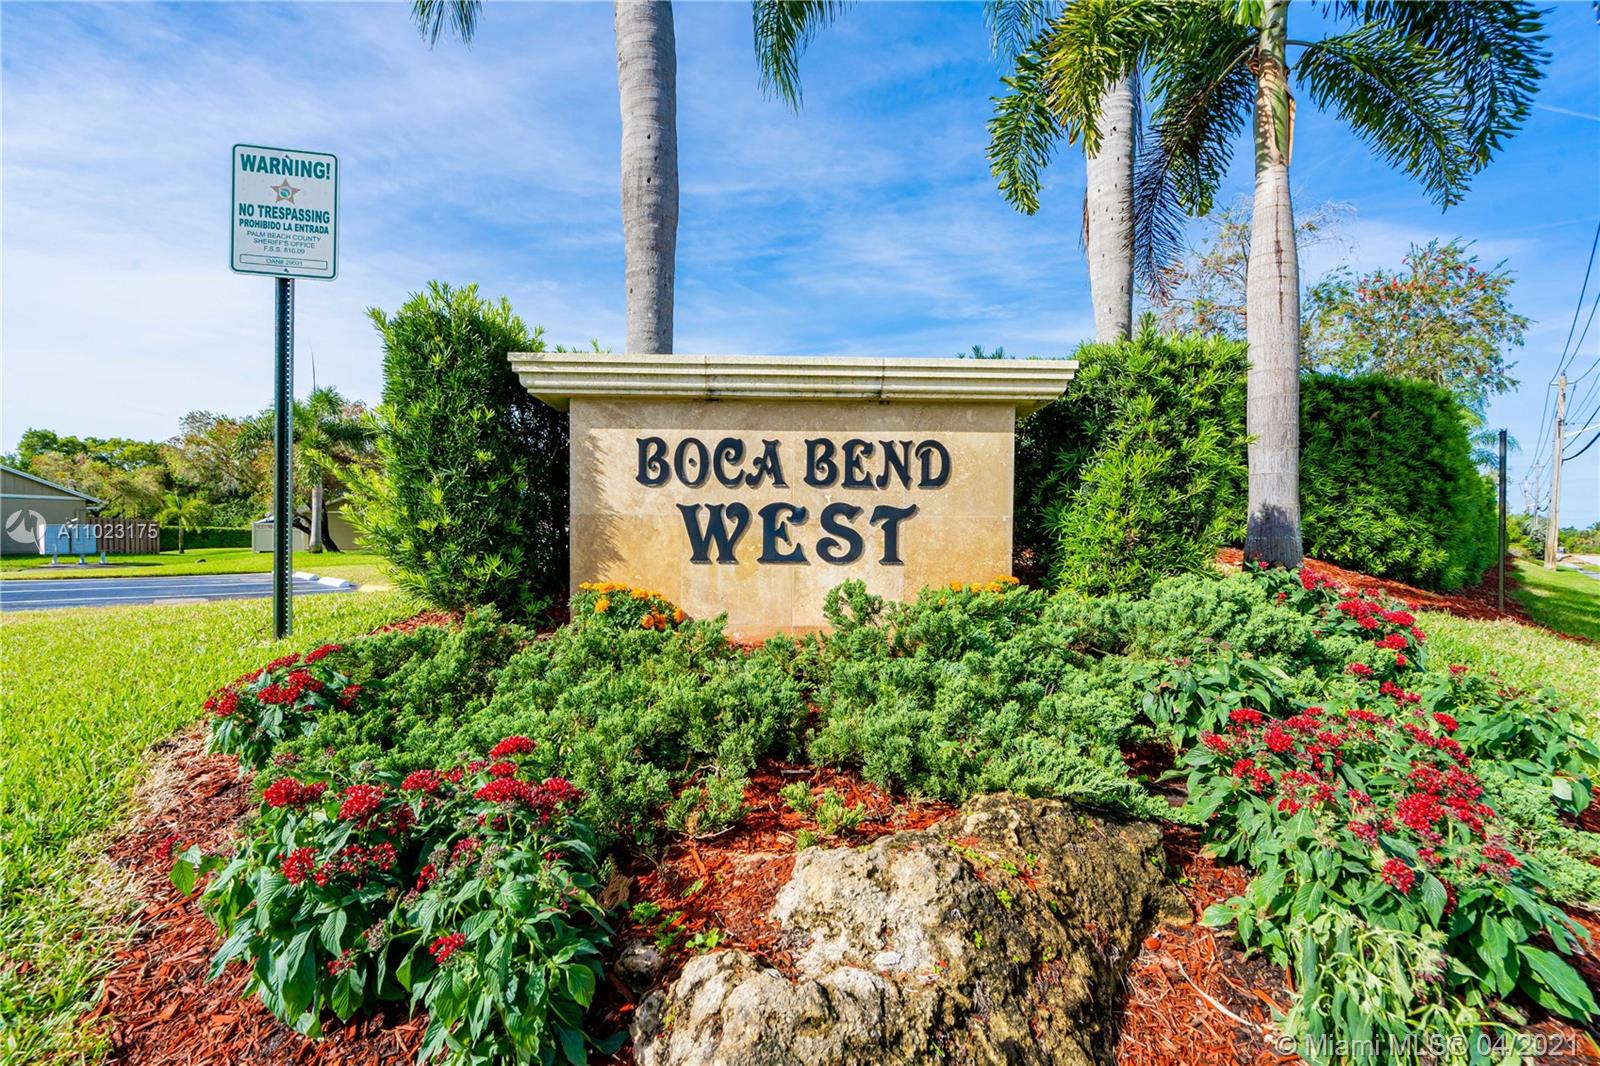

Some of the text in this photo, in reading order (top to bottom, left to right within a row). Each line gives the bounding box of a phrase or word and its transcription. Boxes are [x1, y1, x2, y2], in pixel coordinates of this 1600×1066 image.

[240, 153, 331, 180] WARNING!
[239, 202, 330, 224] NO TRESPASSING
[239, 218, 329, 235] PROHIBIDO LA ENTRADA
[246, 230, 321, 242] PALM BEACH COUNTY
[253, 238, 316, 249] SHERIFF'S OFFICE
[635, 436, 953, 491] BOCA BEND
[676, 501, 920, 566] WEST
